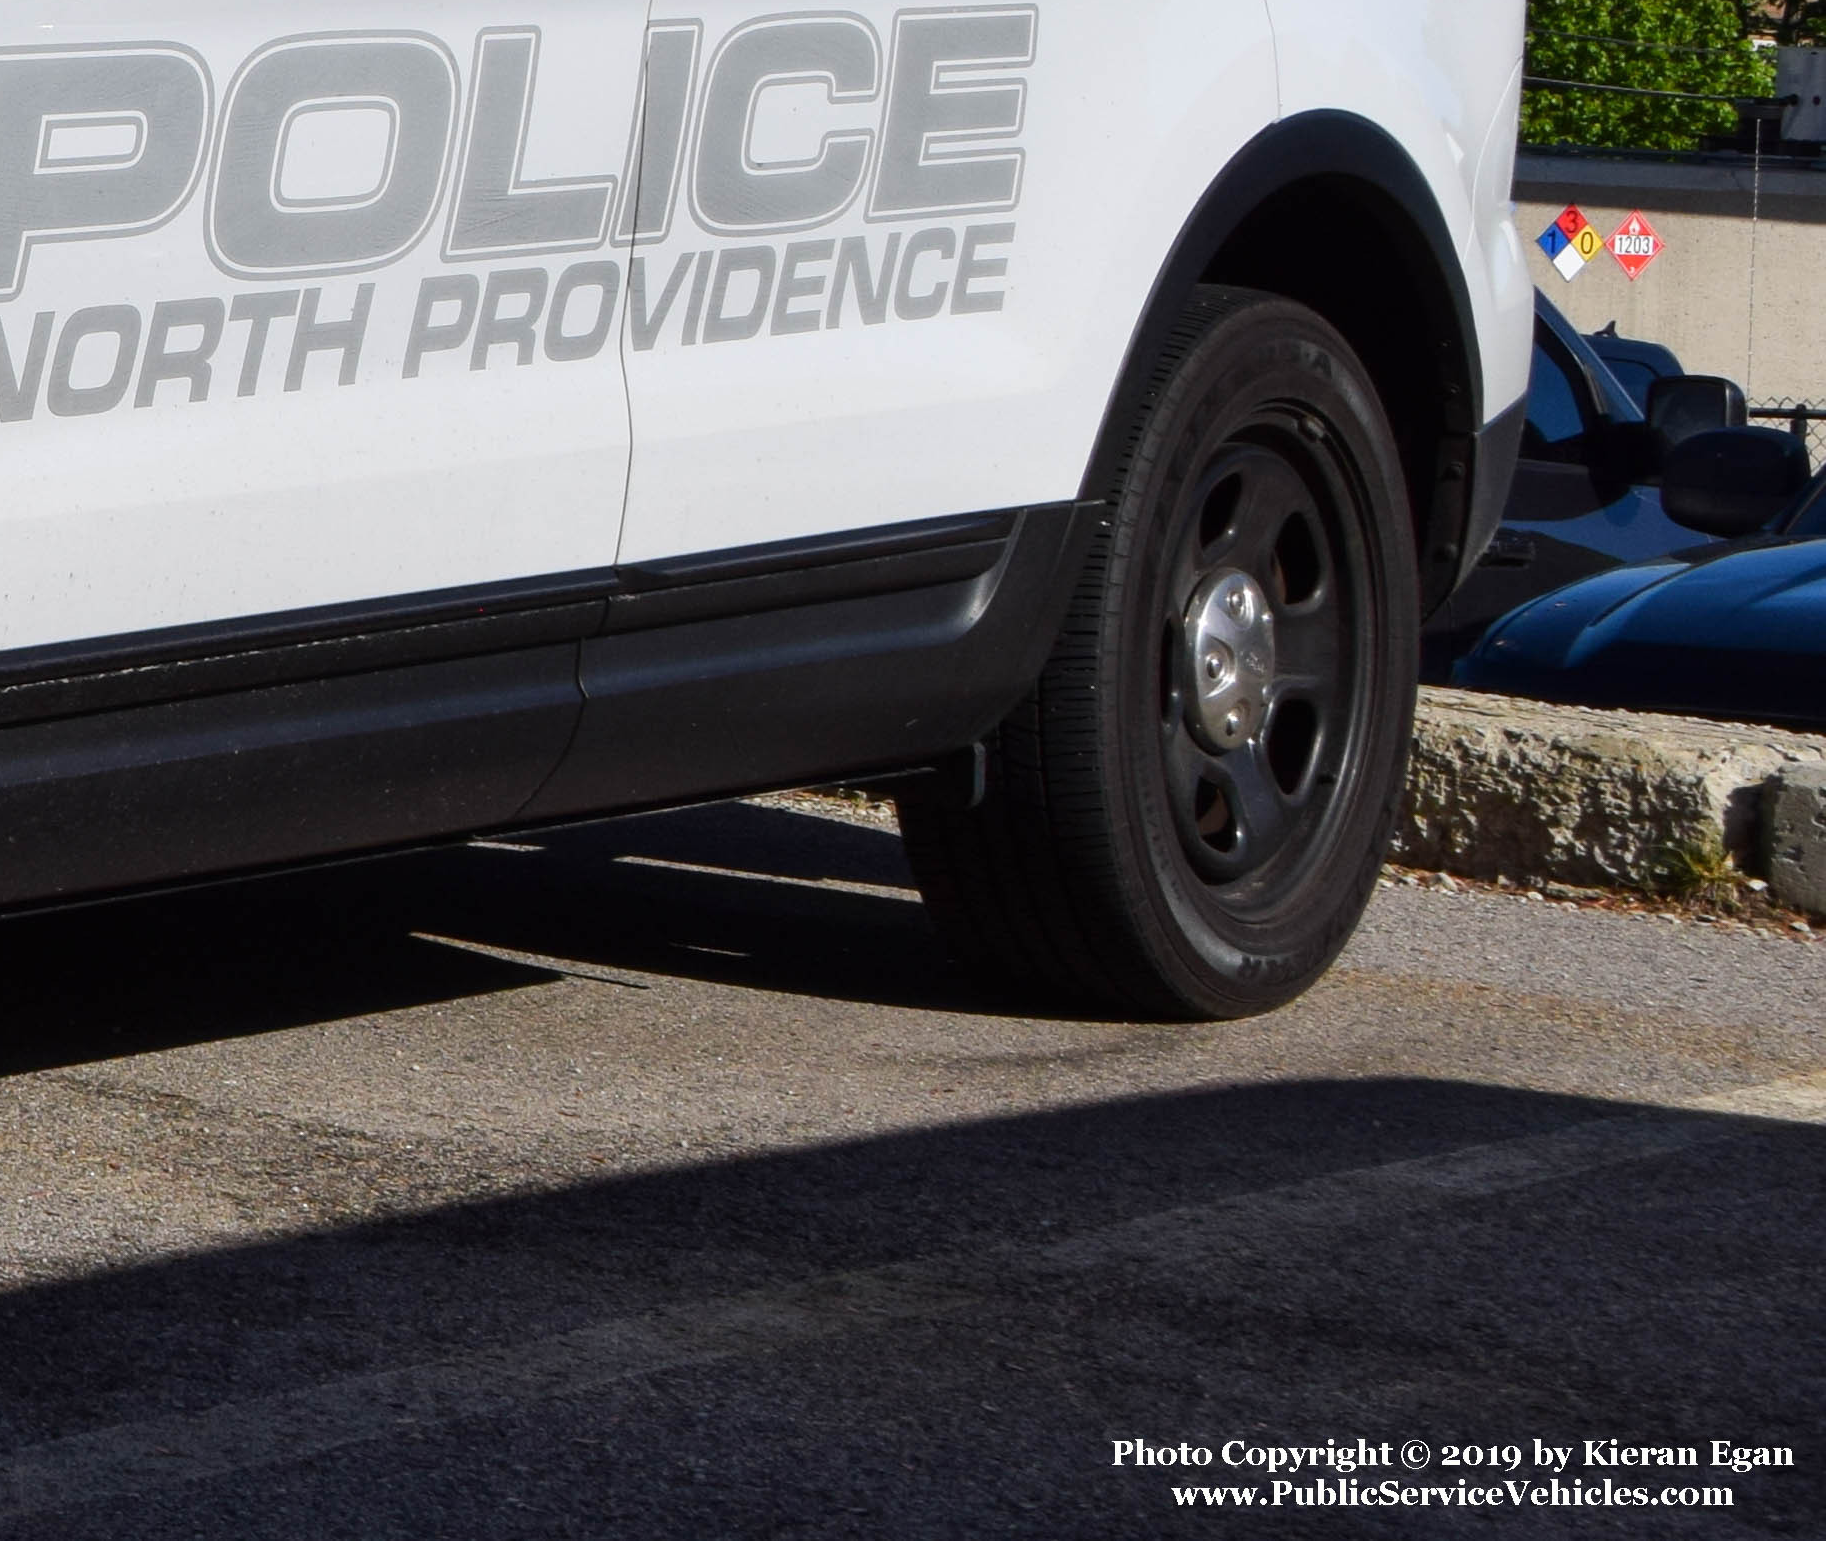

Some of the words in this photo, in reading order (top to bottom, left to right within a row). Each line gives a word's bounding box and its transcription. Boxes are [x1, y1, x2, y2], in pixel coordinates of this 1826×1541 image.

[1565, 211, 1578, 233] 3
[1547, 231, 1556, 254] 1
[1580, 231, 1594, 254] 0
[1618, 236, 1651, 254] 1203
[401, 221, 1017, 380] PROVIDENCE
